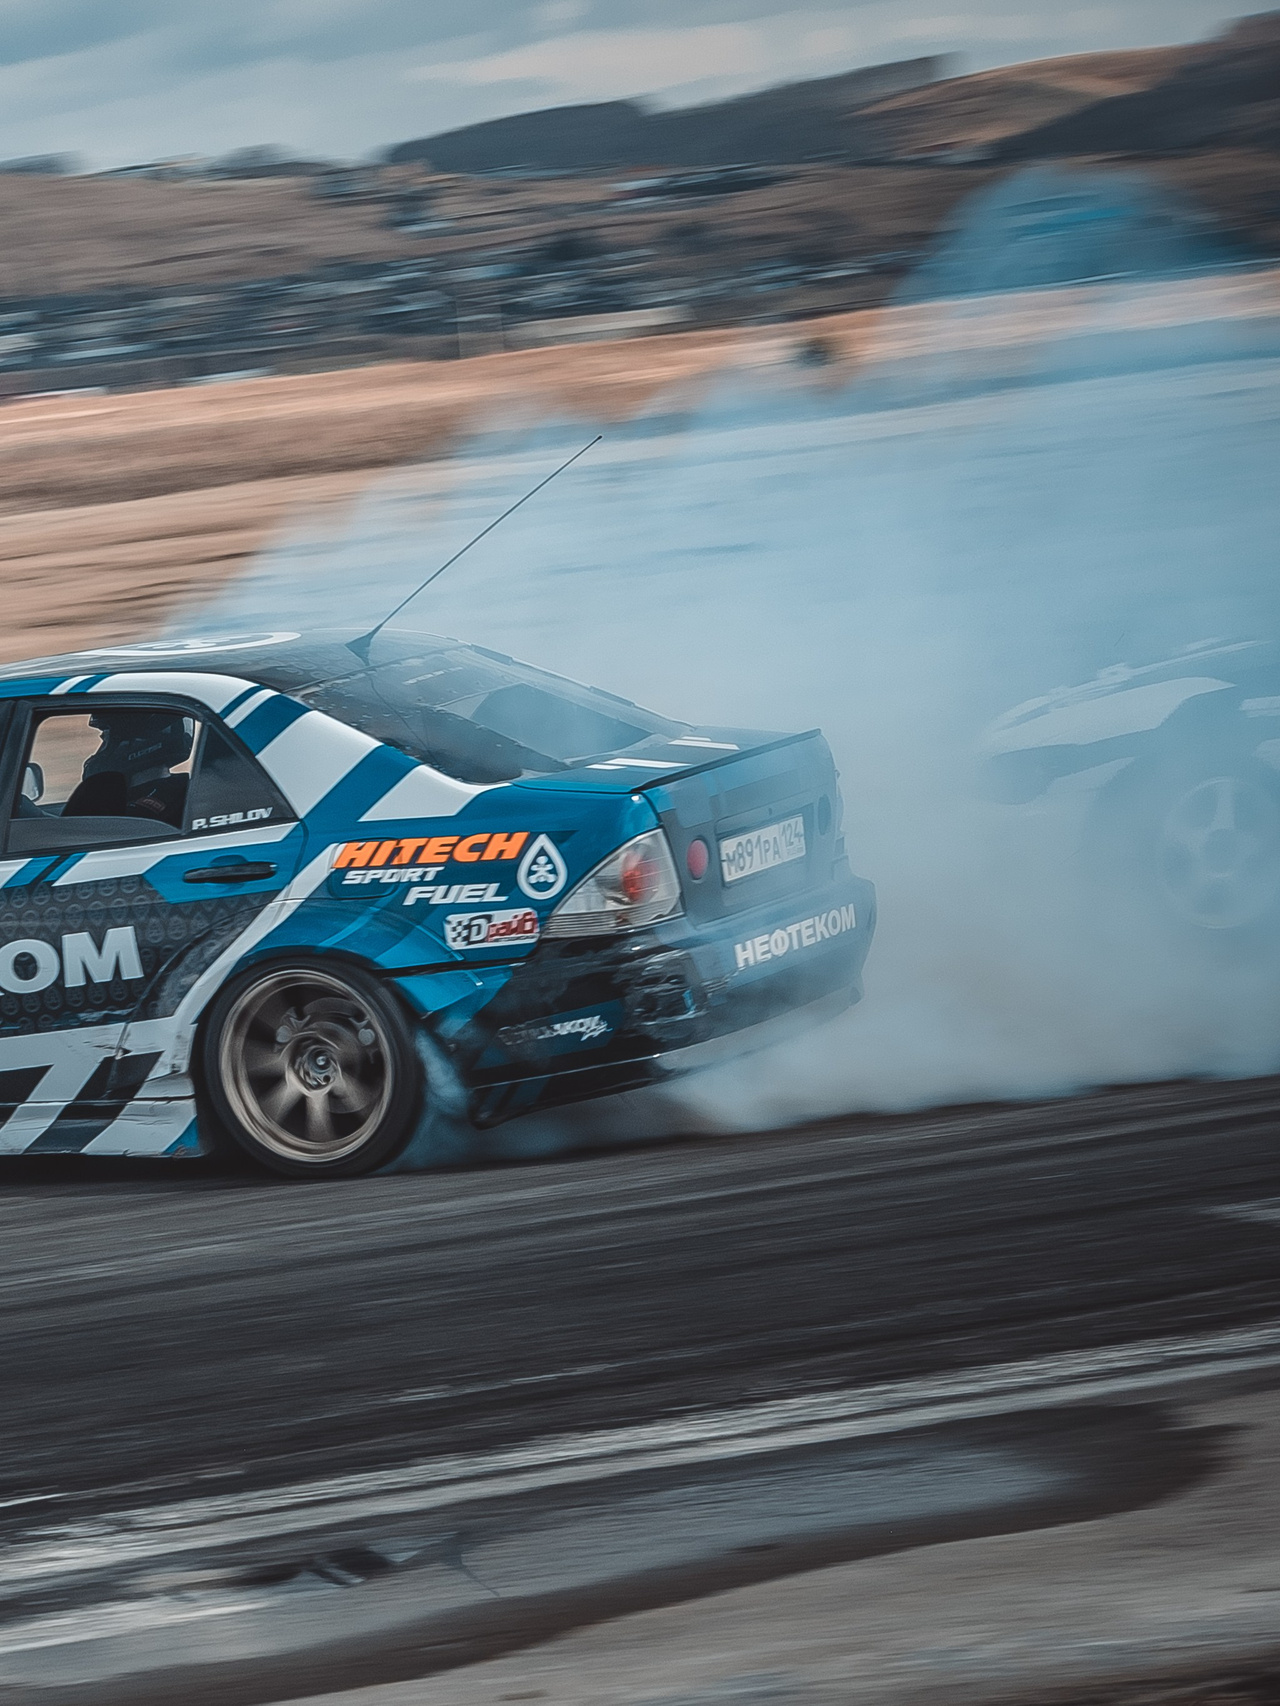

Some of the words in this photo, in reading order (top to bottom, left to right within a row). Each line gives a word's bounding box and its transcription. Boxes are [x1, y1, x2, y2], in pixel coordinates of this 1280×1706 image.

[332, 832, 530, 869] HITECH
[342, 866, 445, 885] SPORT
[402, 883, 509, 906] FUEL
[734, 903, 857, 971] НЕФТЕКОМ
